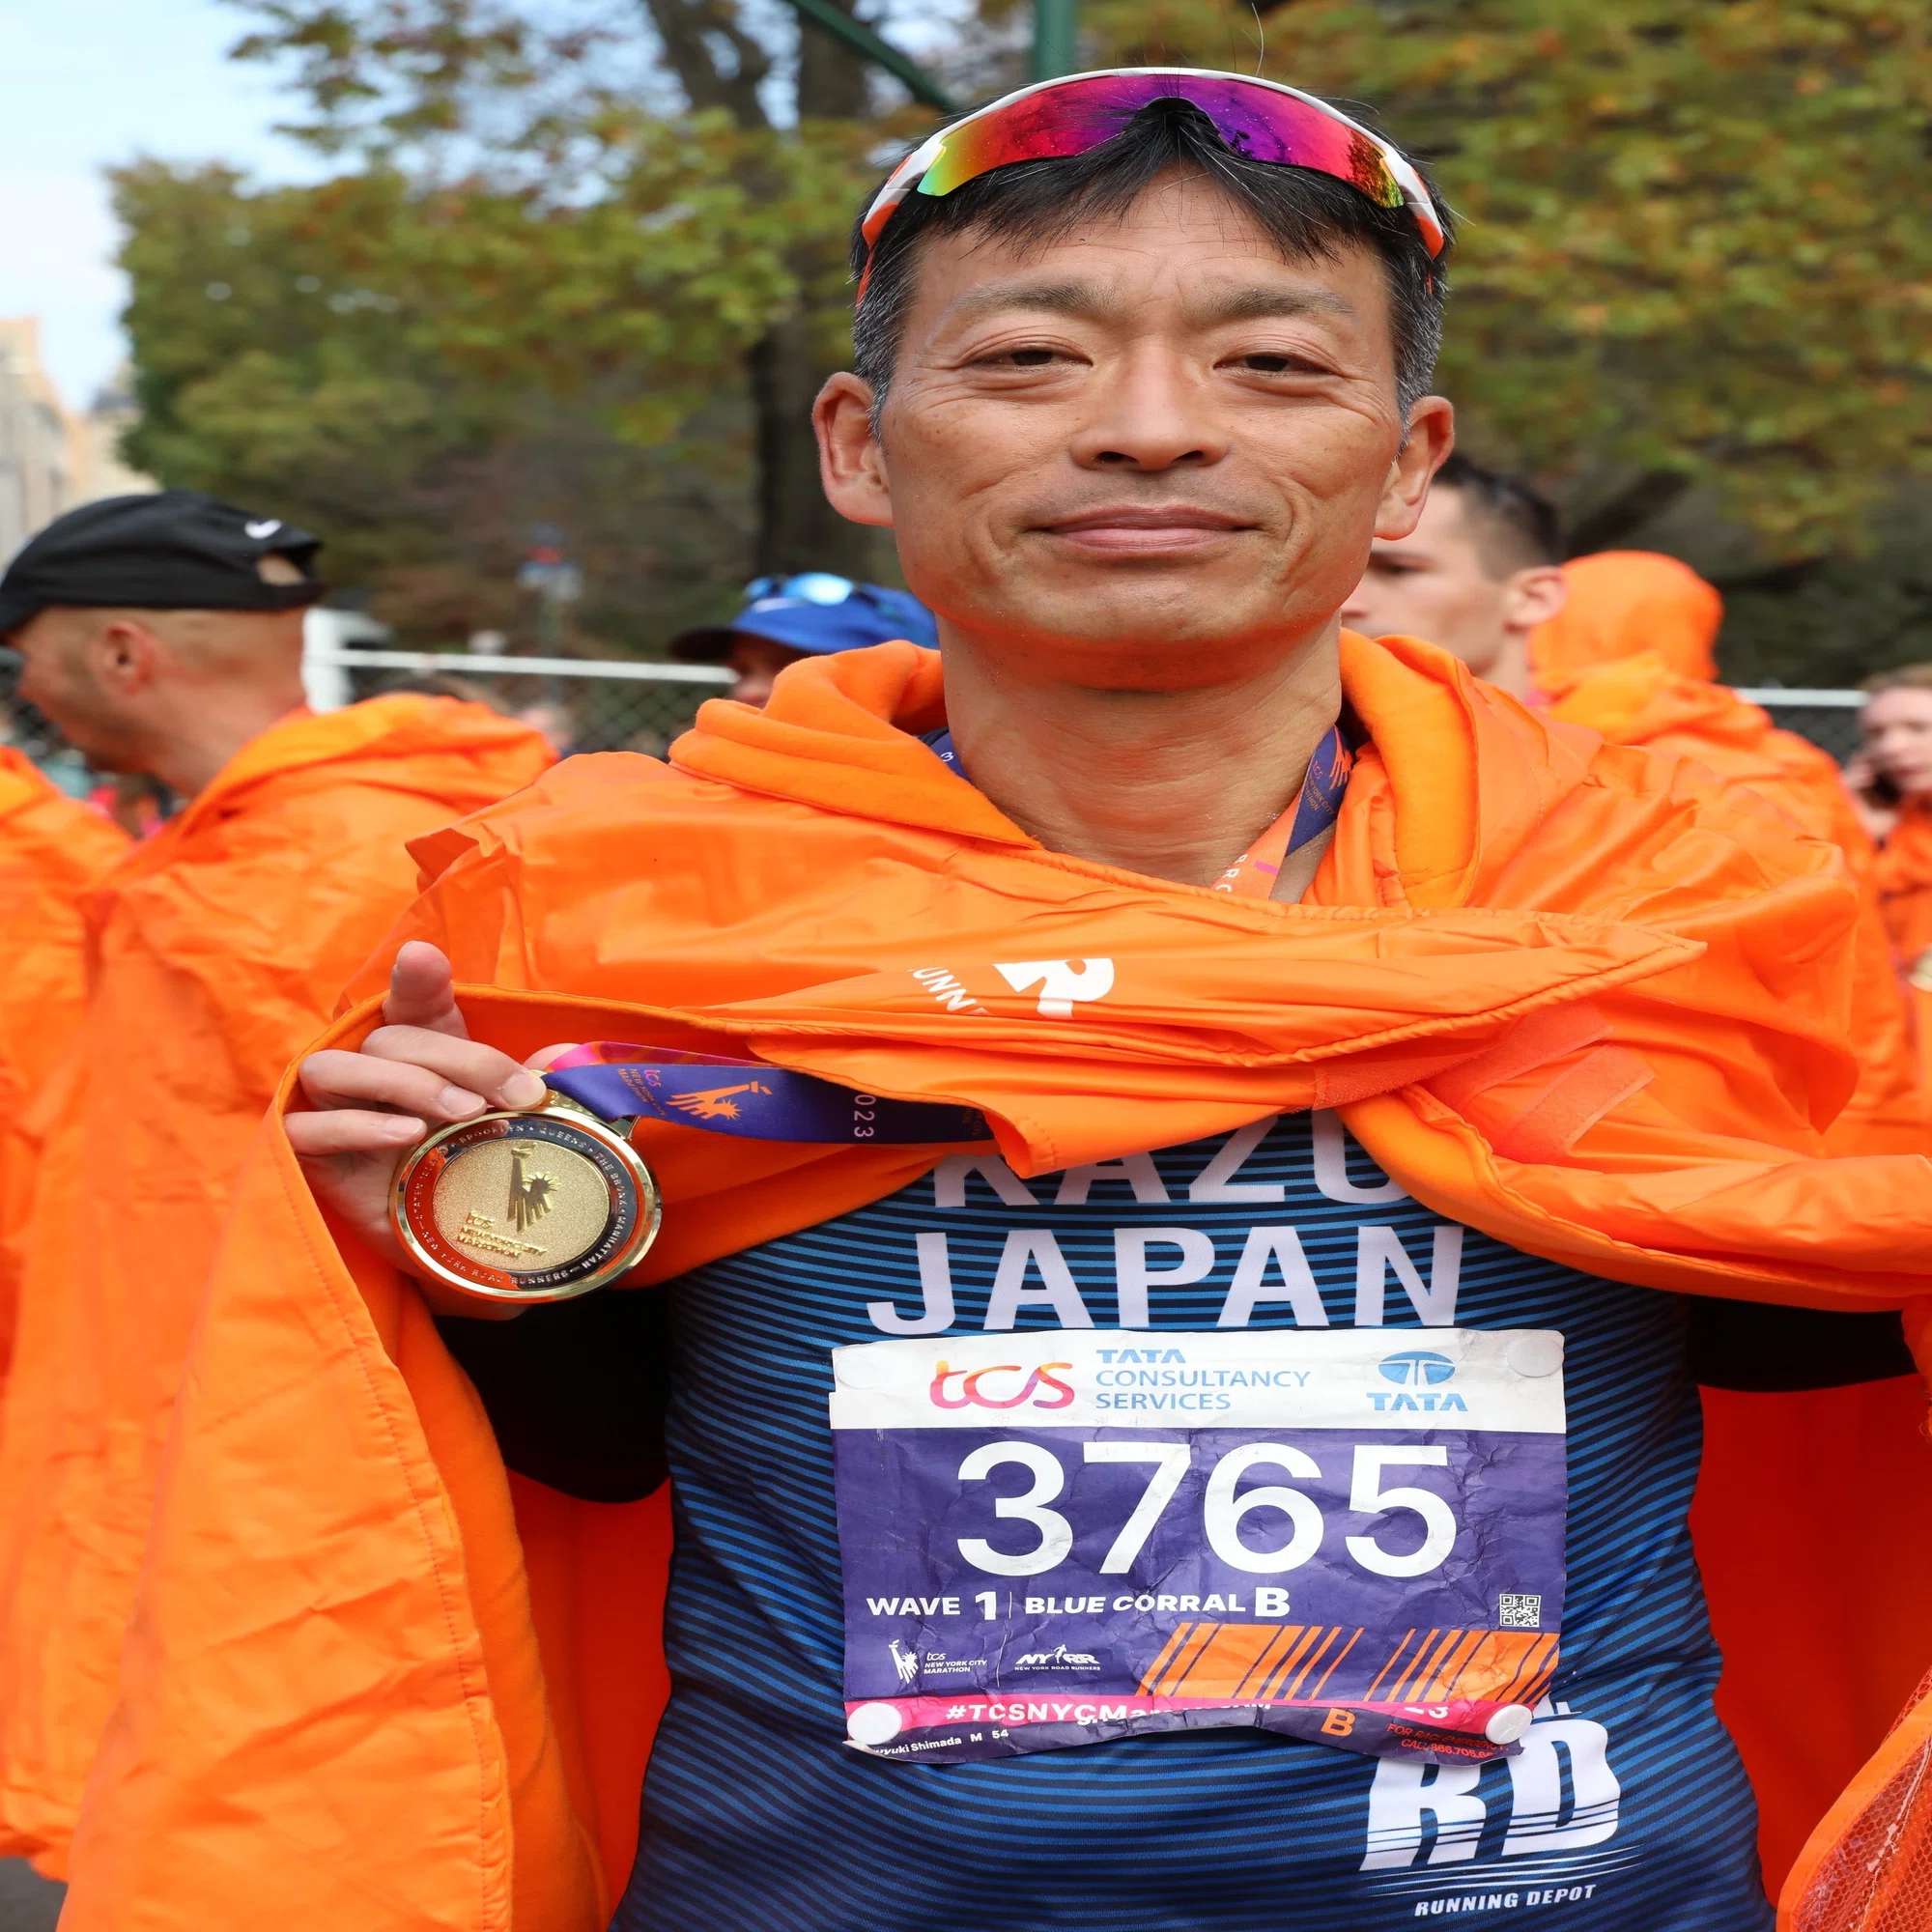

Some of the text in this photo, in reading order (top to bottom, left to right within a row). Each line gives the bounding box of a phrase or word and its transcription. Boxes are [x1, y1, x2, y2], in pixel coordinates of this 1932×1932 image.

[854, 1094, 876, 1138] 023
[867, 1225, 1464, 1335] JAPAN
[1096, 1349, 1186, 1364] TATA
[929, 1360, 1075, 1409] tcs
[1095, 1370, 1311, 1388] CONSULTANCY
[1095, 1392, 1231, 1410] SERVICES
[1367, 1393, 1468, 1412] TATA
[956, 1441, 1458, 1578] 3765
[867, 1586, 1291, 1621] WAVE 1 BLUE CORRAL B
[926, 1652, 947, 1661] tcs
[1321, 1708, 1356, 1737] B
[1386, 1722, 1413, 1736] FOR
[911, 1736, 962, 1752] Shimada
[970, 1732, 983, 1743] M
[991, 1728, 1009, 1740] 54
[1414, 1884, 1597, 1918] RUNNING DEPOT
